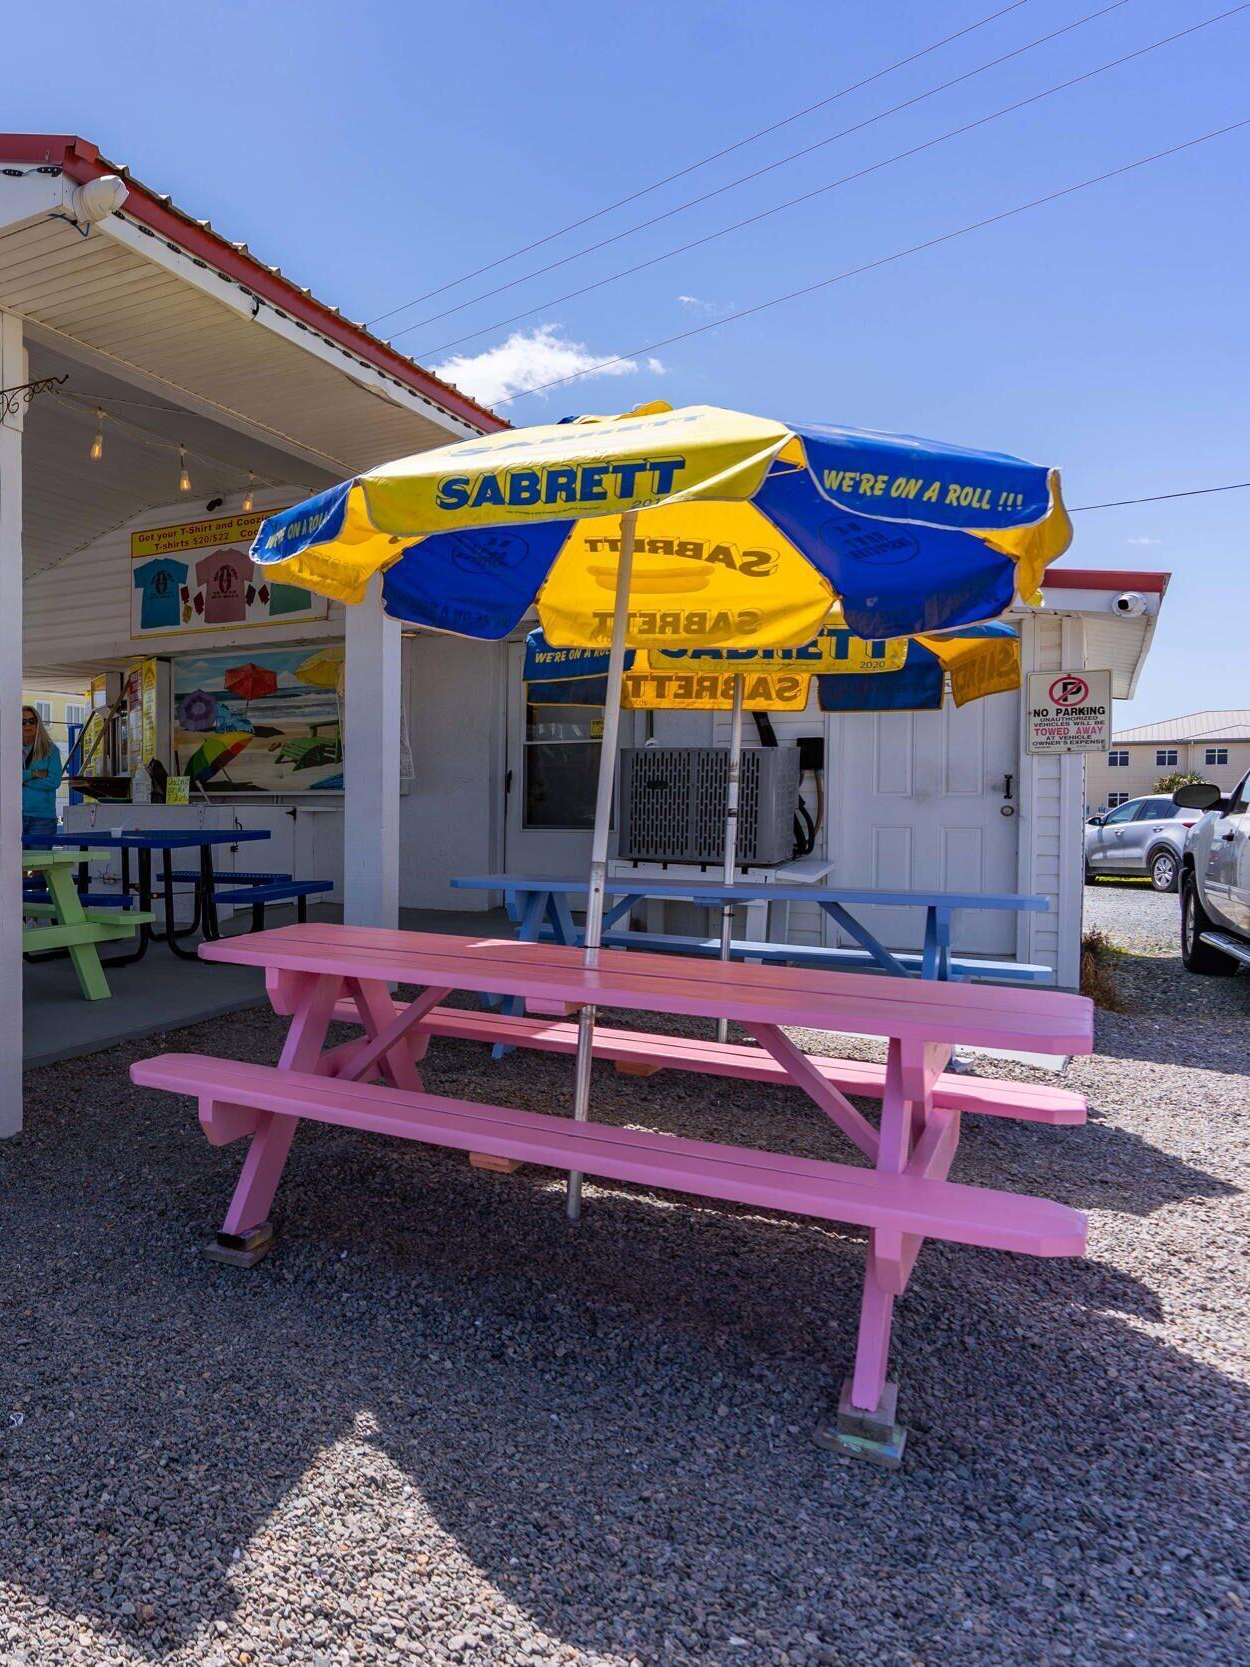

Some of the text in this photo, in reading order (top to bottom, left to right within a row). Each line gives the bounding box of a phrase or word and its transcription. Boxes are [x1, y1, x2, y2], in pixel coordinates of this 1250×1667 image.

[436, 455, 686, 510] SABRETT
[823, 469, 1023, 511] WE'RE ON A ROLL !!!
[631, 499, 661, 509] 201
[138, 532, 154, 543] Get
[157, 530, 177, 541] your
[180, 524, 212, 536] T-Shirt
[216, 520, 233, 530] and
[287, 521, 301, 539] ON
[155, 540, 190, 551] T-shirts
[193, 532, 229, 545] $20/$22
[535, 651, 567, 664] WE'RE
[569, 649, 580, 660] ON
[860, 660, 885, 669] 2020
[1033, 706, 1106, 718] NO PARKING
[1034, 726, 1103, 736] TOWED AWAY
